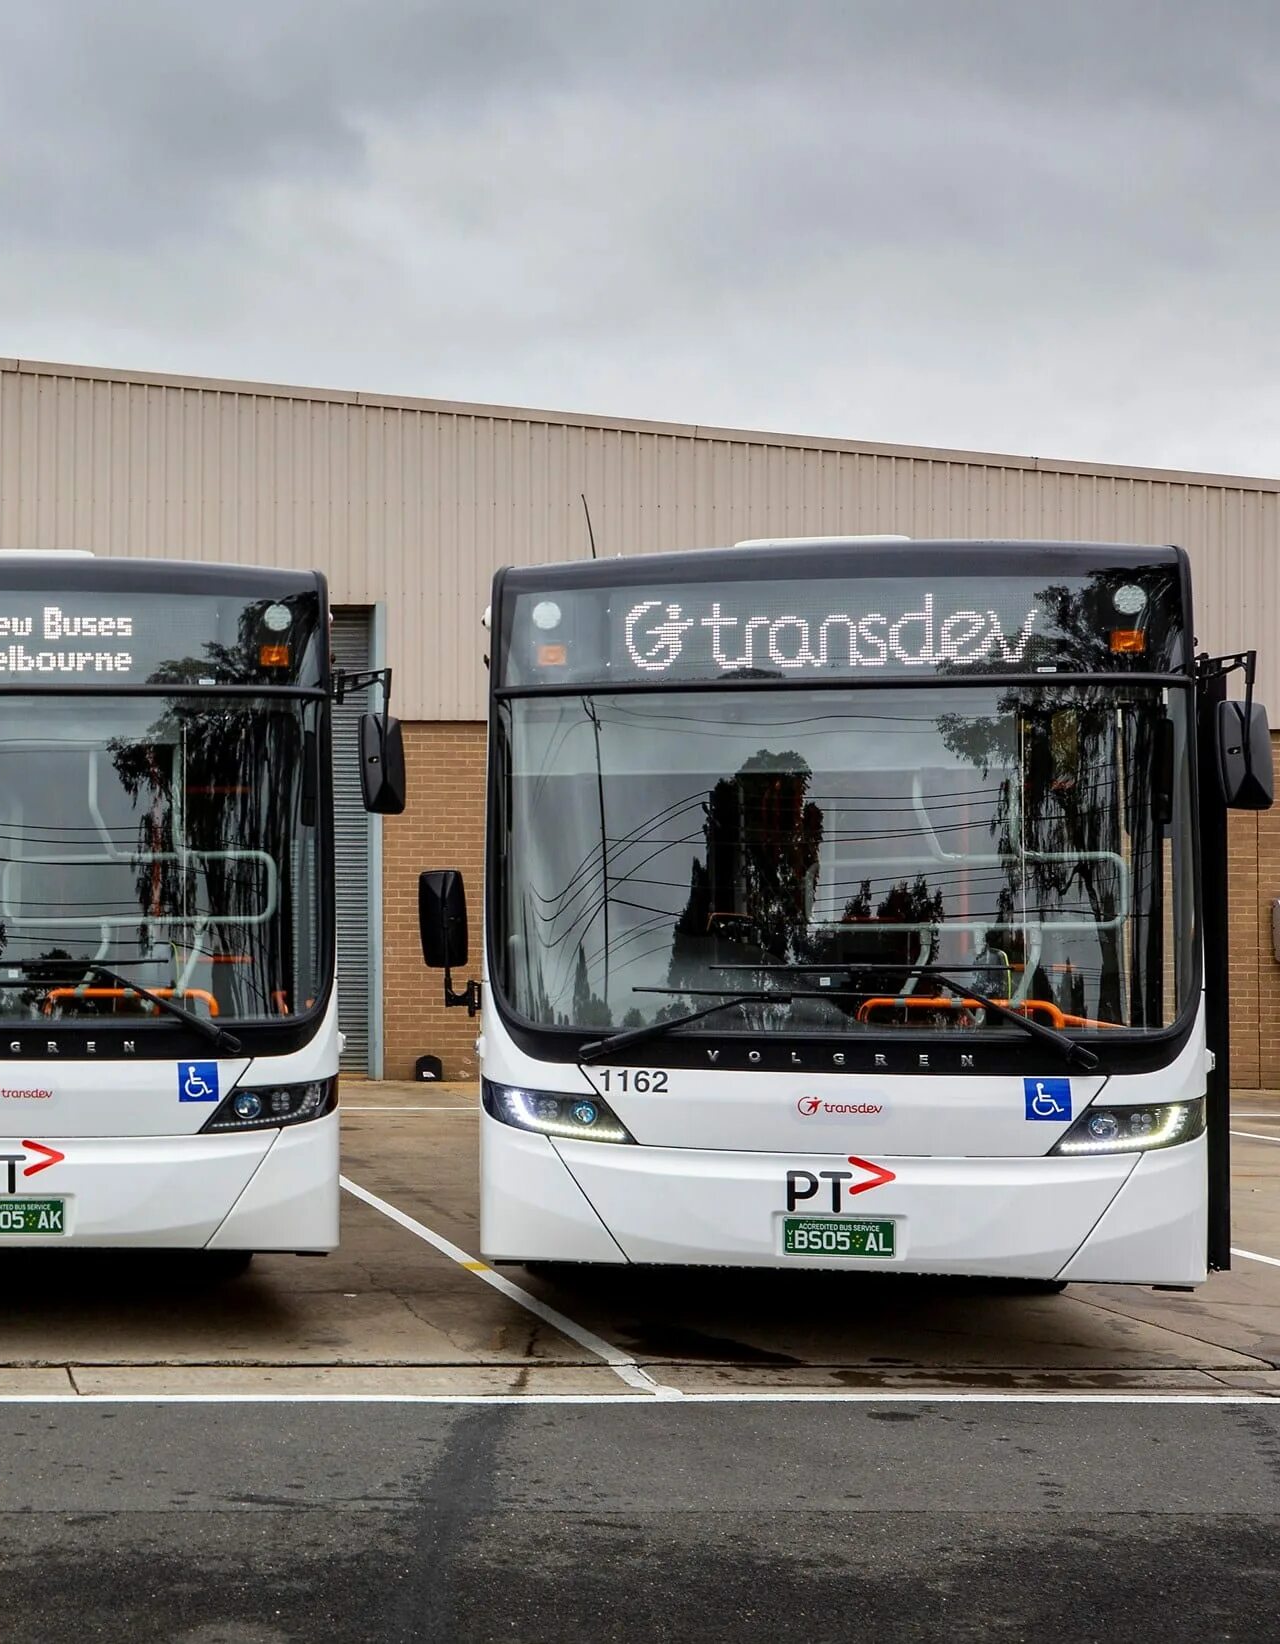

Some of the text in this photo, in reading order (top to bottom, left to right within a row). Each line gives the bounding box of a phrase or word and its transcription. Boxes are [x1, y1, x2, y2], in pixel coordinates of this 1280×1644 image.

[43, 606, 133, 639] Buses
[700, 593, 1039, 669] transdev
[706, 1049, 975, 1068] VOLGREN
[599, 1069, 669, 1094] 1162
[1, 1088, 54, 1100] transdev
[823, 1102, 884, 1115] transdev
[37, 1210, 62, 1229] AK
[798, 1223, 839, 1231] ACCREDITED
[794, 1229, 893, 1252] BS05 AL
